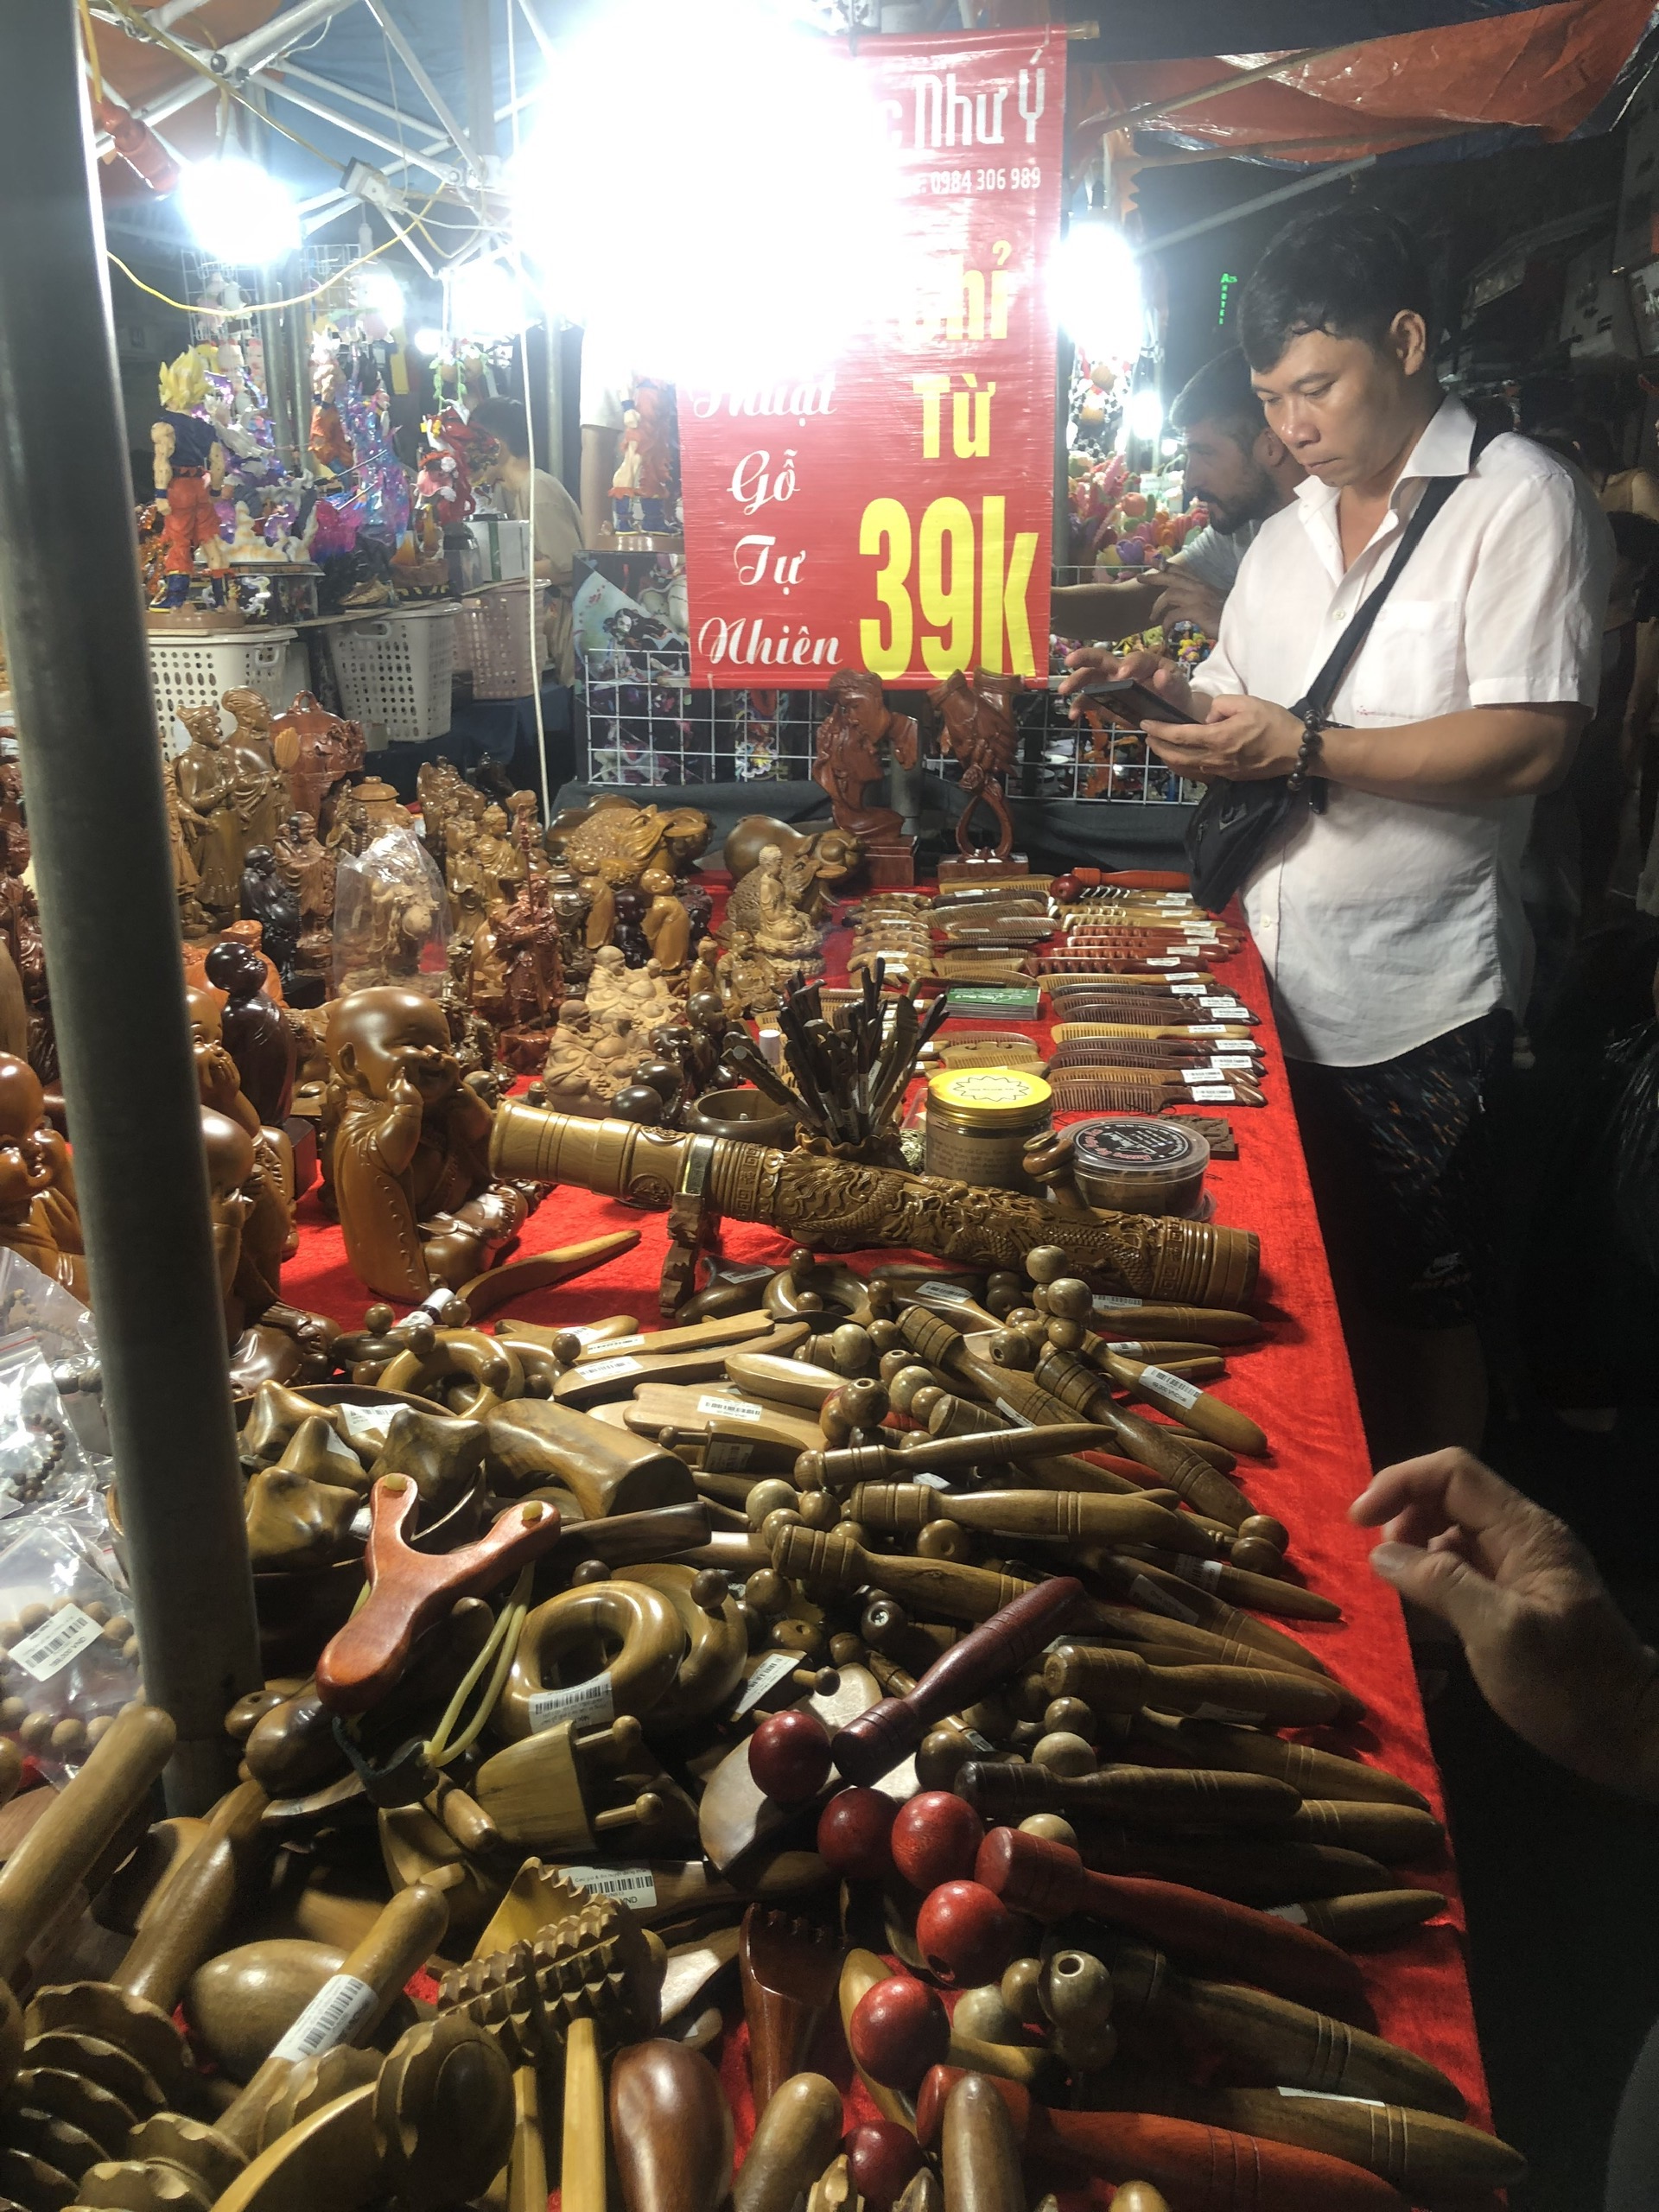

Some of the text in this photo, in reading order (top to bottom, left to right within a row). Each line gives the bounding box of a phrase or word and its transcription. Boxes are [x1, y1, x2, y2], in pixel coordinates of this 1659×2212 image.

[912, 73, 1008, 149] Như
[1018, 48, 1046, 143] Ý
[931, 170, 972, 194] 0984
[976, 168, 1007, 191] 306
[1010, 166, 1041, 189] 989
[912, 373, 996, 459] Từ
[727, 448, 801, 516] Gỗ
[734, 534, 807, 595] Tự
[859, 495, 1039, 681] 39k
[697, 616, 843, 665] Nhiên
